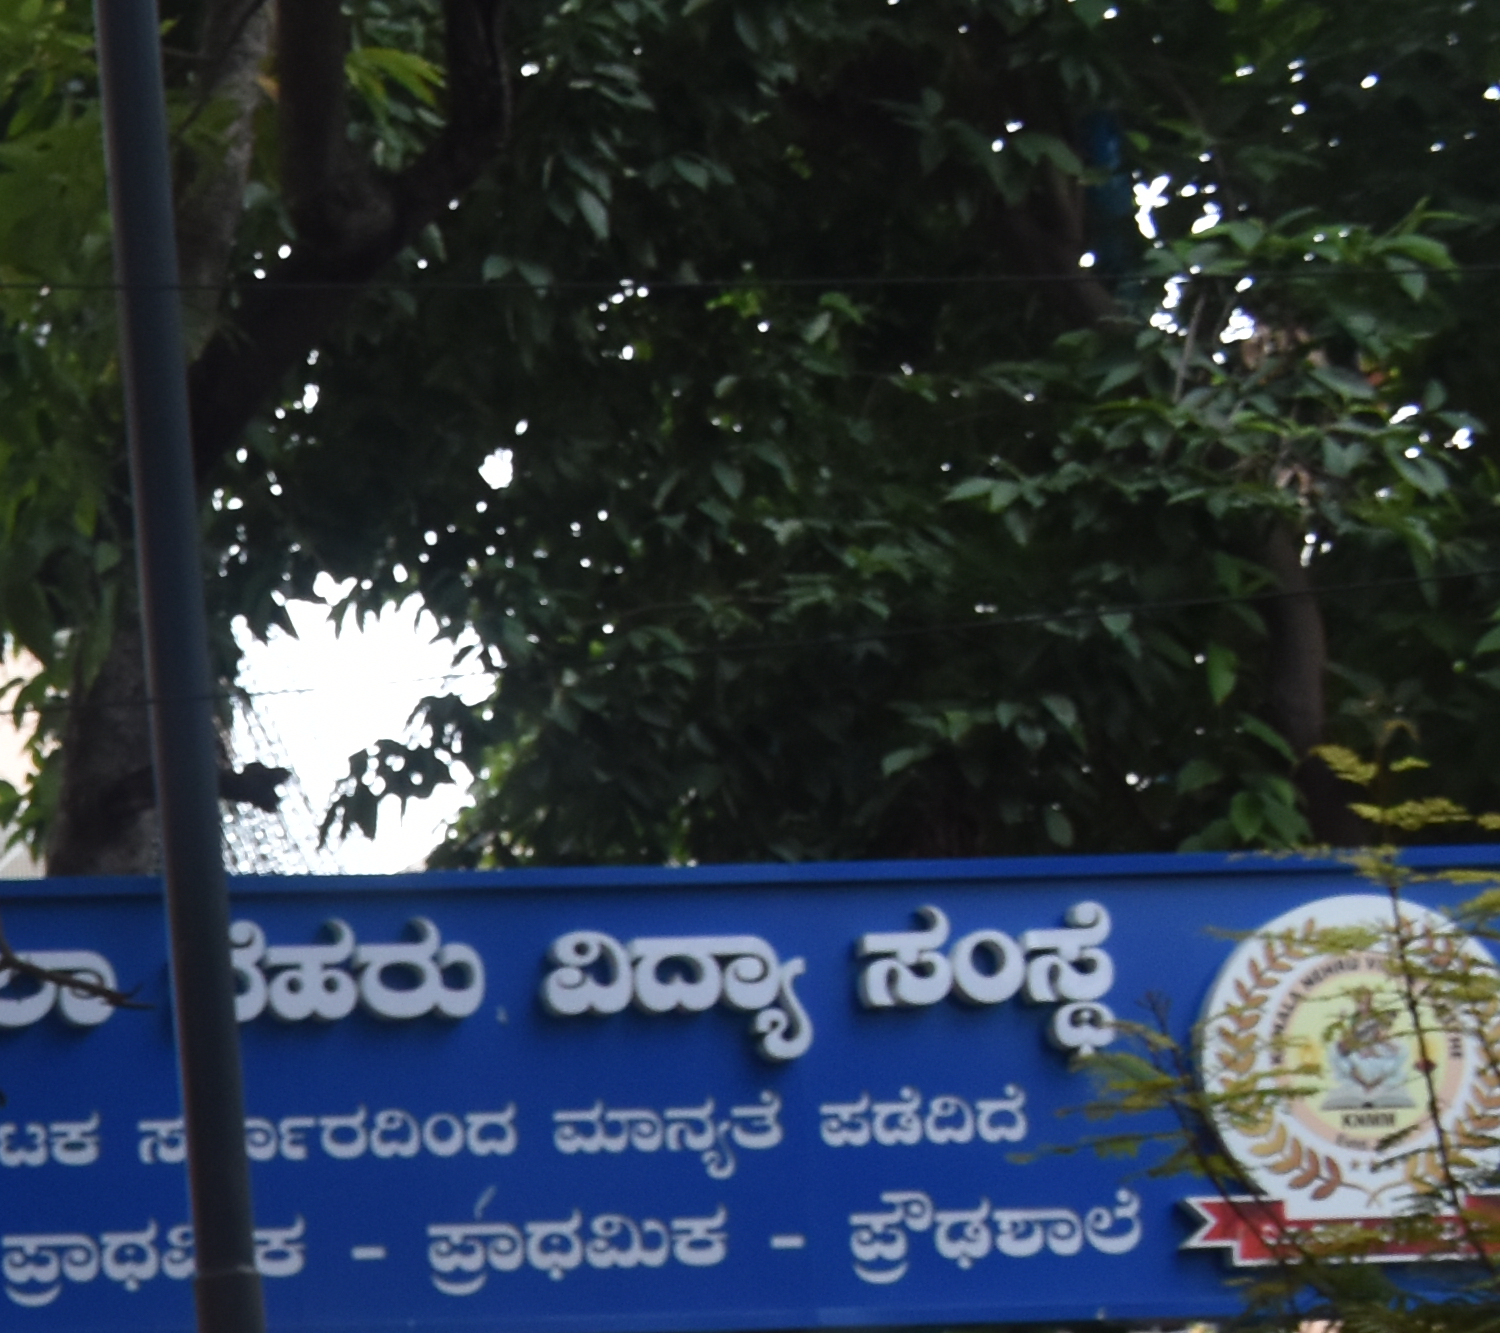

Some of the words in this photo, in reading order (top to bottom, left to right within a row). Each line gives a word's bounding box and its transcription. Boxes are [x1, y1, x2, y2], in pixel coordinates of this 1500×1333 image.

[545, 929, 813, 1062] ವಿದ್ಯಾ
[861, 900, 1117, 1057] ಸಂಸ್ಥೆ
[139, 1103, 518, 1164] ಸರ್ಾರದಿಂದ
[553, 1090, 783, 1179] ಮಾನ್ಯತೆ
[820, 1084, 1029, 1149] ಪಡೆದಿದೆ
[427, 1205, 729, 1296] ಪ್ರಾಥಮಿಕ
[850, 1187, 1143, 1285] ಪ್ರೌಢಶಾಲೆ
